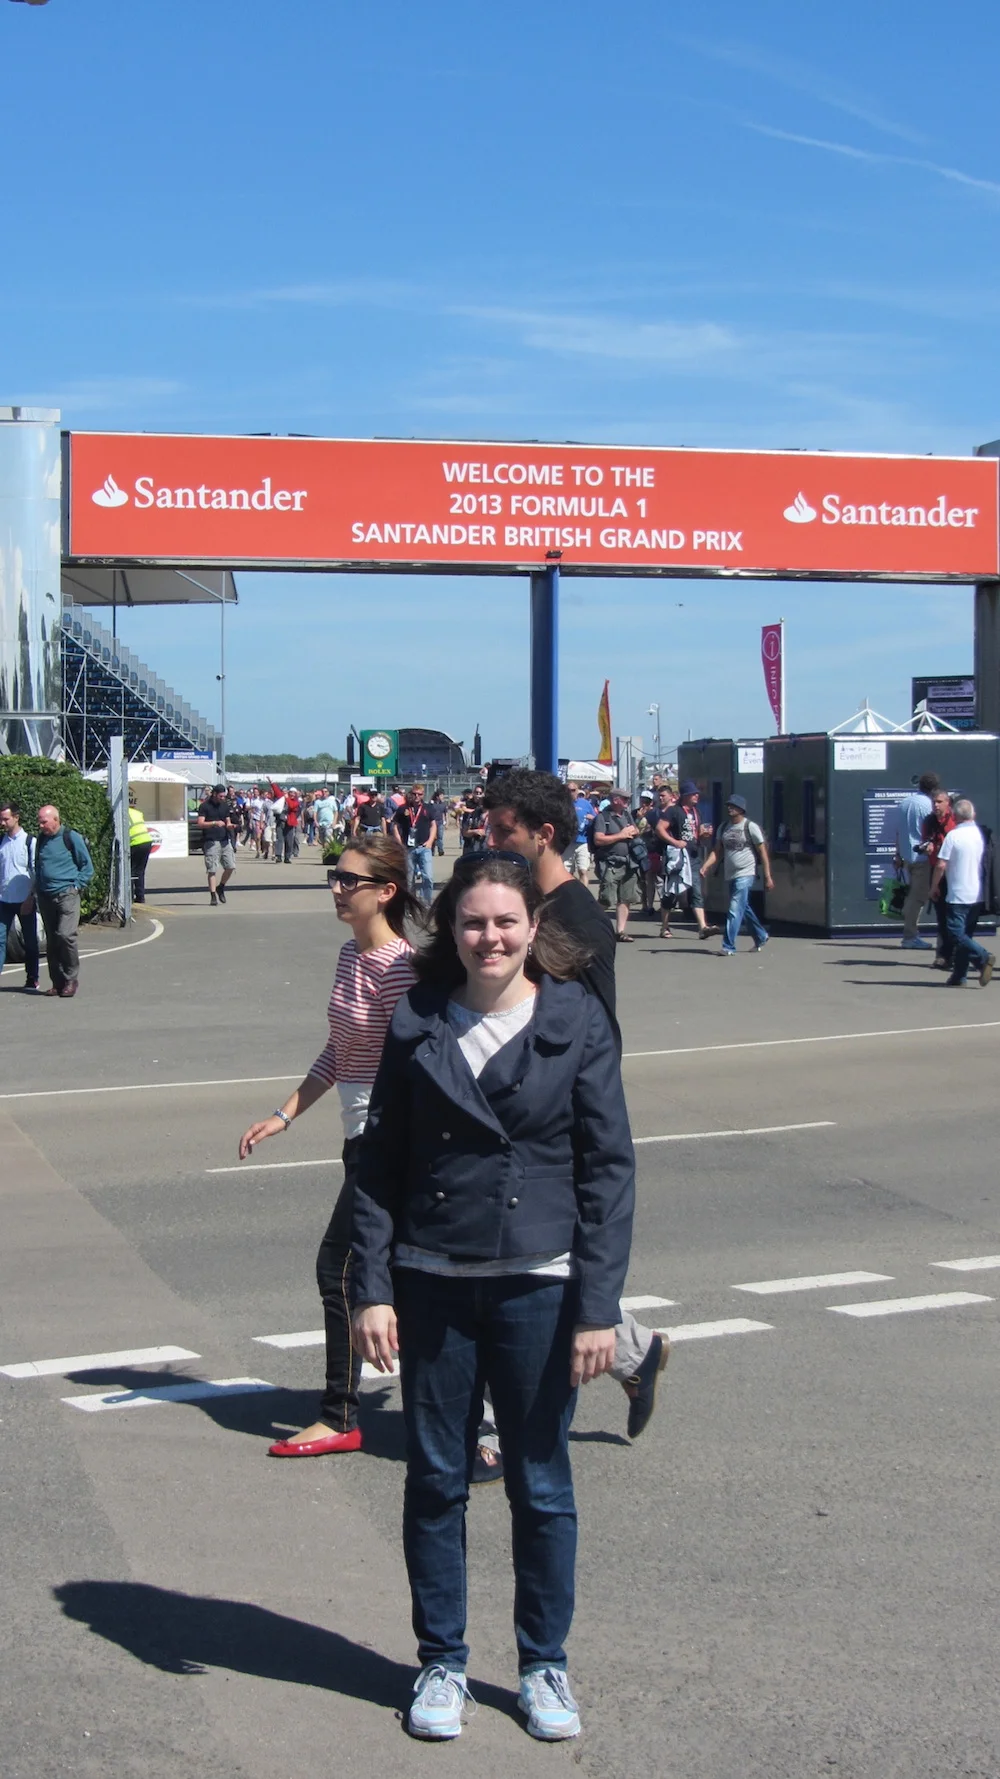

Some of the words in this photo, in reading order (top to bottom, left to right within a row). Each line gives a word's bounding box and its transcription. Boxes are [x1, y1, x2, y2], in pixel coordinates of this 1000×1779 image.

[442, 462, 564, 487] WELCOME
[570, 465, 604, 487] TO
[610, 466, 655, 489] THE
[134, 476, 308, 512] Santander
[449, 493, 503, 515] 2013
[510, 495, 629, 518] FORMULA
[636, 498, 648, 519] 1
[821, 494, 979, 528] Santander
[351, 522, 497, 546] SANTANDER
[503, 525, 592, 548] BRITISH
[599, 527, 686, 550] GRAND
[692, 530, 744, 552] PRIX
